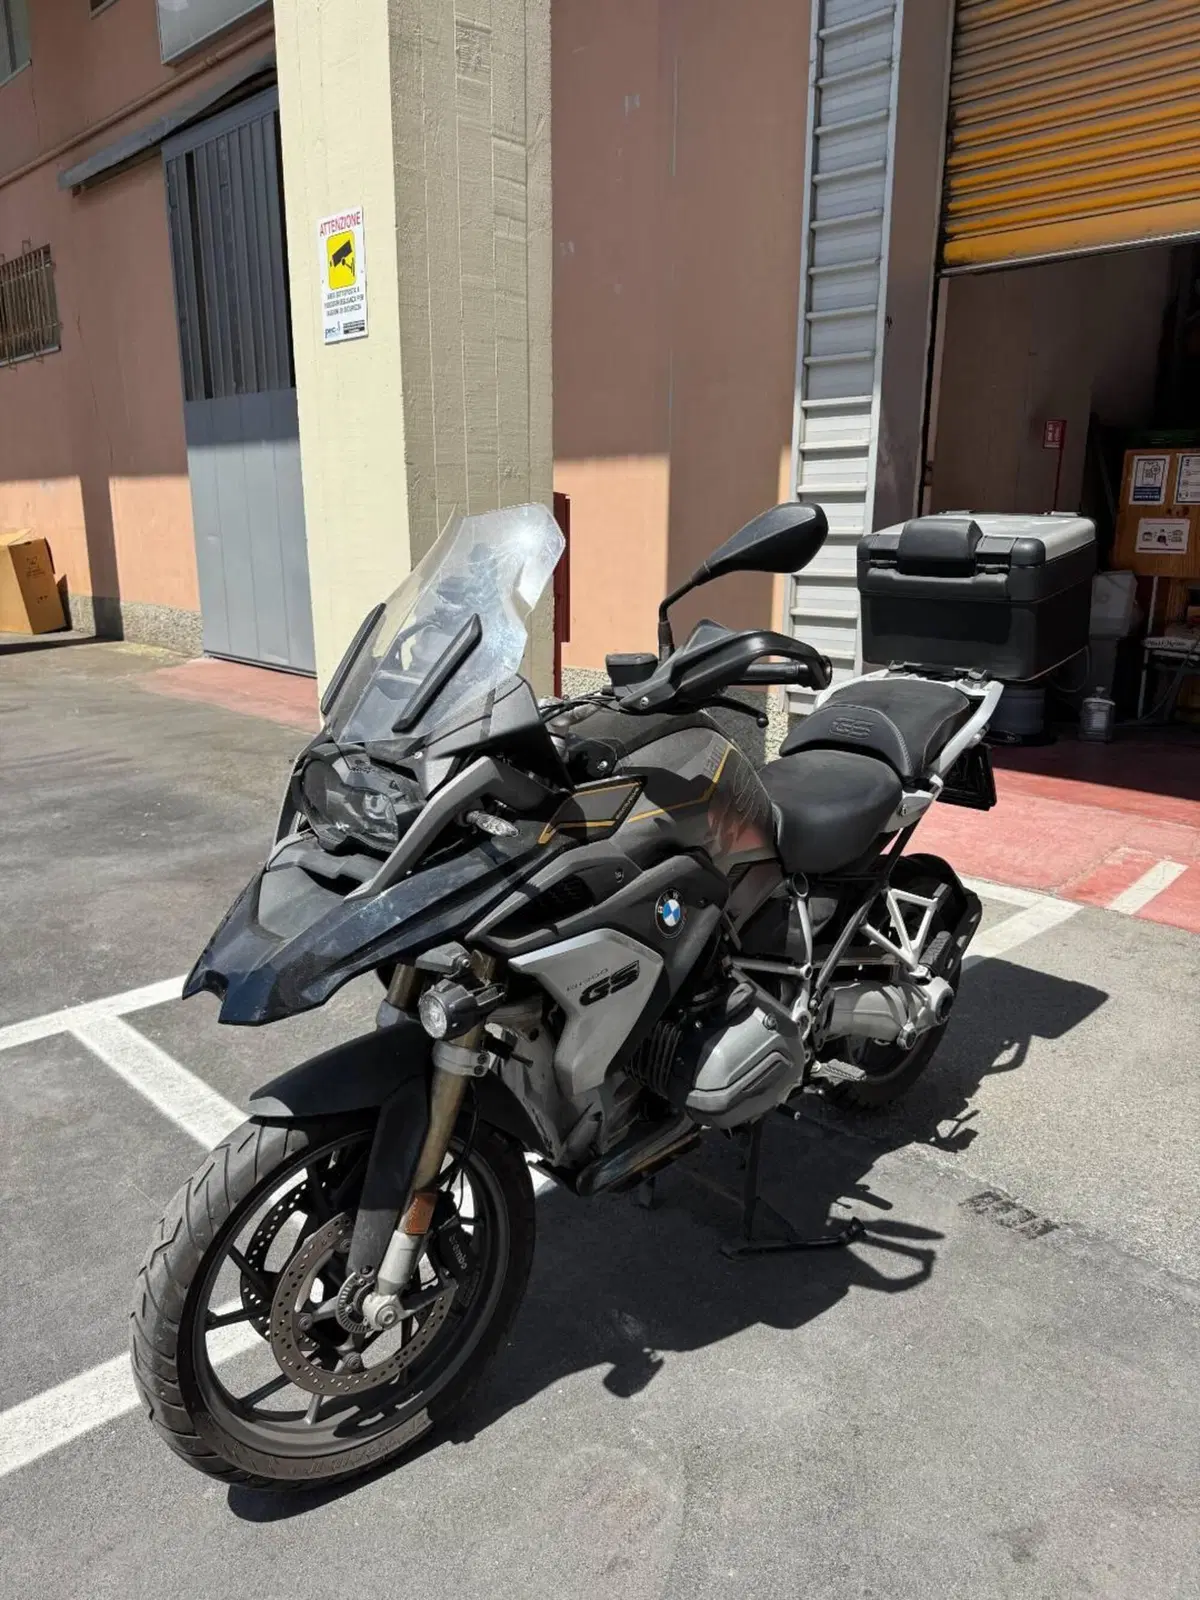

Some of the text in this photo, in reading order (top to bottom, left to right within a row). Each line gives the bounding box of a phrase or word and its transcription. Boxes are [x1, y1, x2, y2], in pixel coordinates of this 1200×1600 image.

[319, 211, 361, 237] ATTENZIONE
[579, 959, 640, 1006] GS
[449, 1232, 468, 1270] brembo
